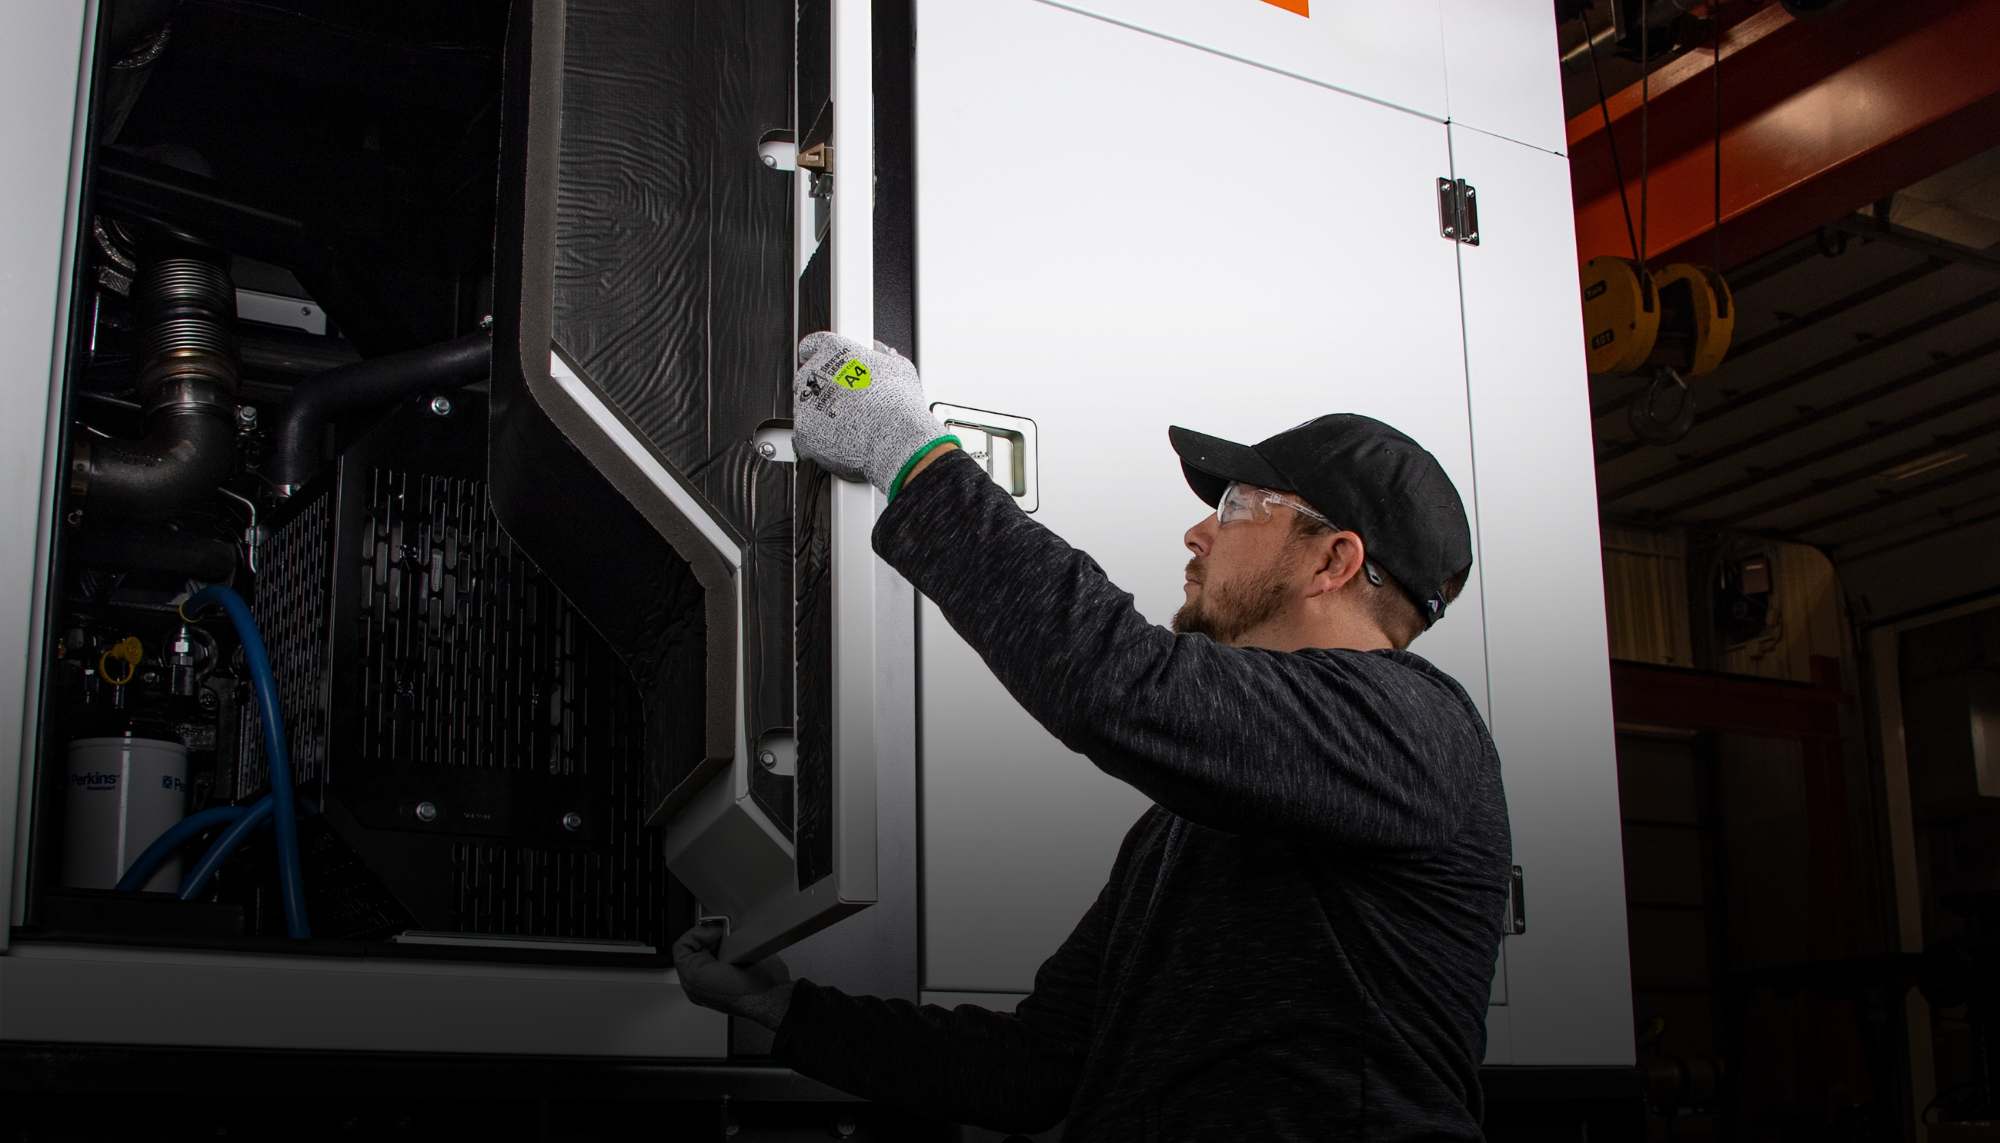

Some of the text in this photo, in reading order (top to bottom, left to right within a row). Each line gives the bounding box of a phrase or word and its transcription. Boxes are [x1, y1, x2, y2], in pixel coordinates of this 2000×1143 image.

[828, 358, 846, 376] GEAR
[836, 360, 857, 381] ANSI CUT
[845, 366, 867, 388] A4
[72, 772, 116, 786] Perkins
